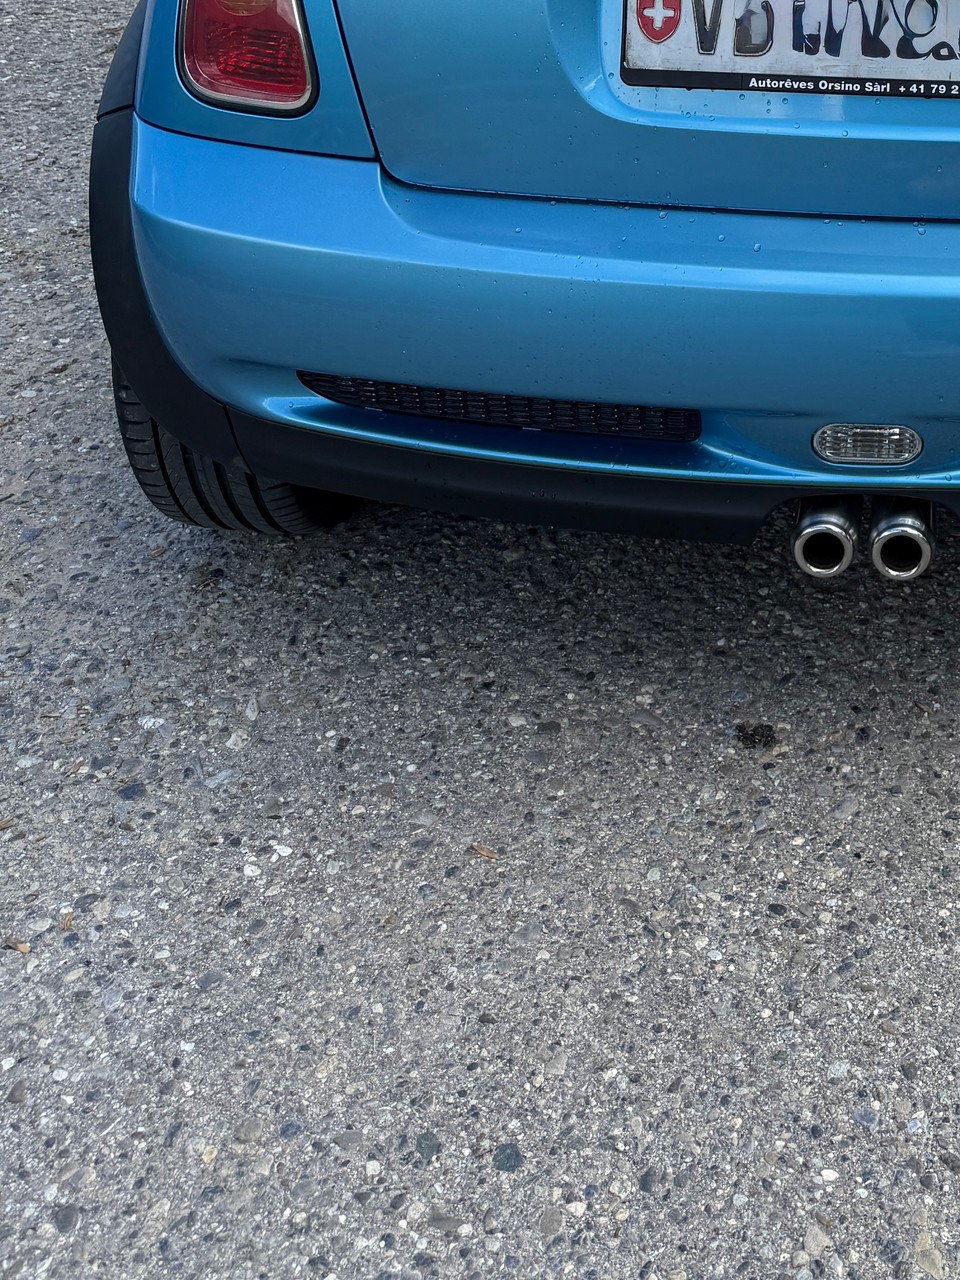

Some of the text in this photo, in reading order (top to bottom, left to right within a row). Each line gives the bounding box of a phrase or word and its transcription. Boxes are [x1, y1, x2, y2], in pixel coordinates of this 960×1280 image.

[748, 77, 815, 90] Autorêves
[818, 79, 861, 92] Orsino
[864, 81, 890, 93] Sàrl
[930, 84, 947, 94] 79
